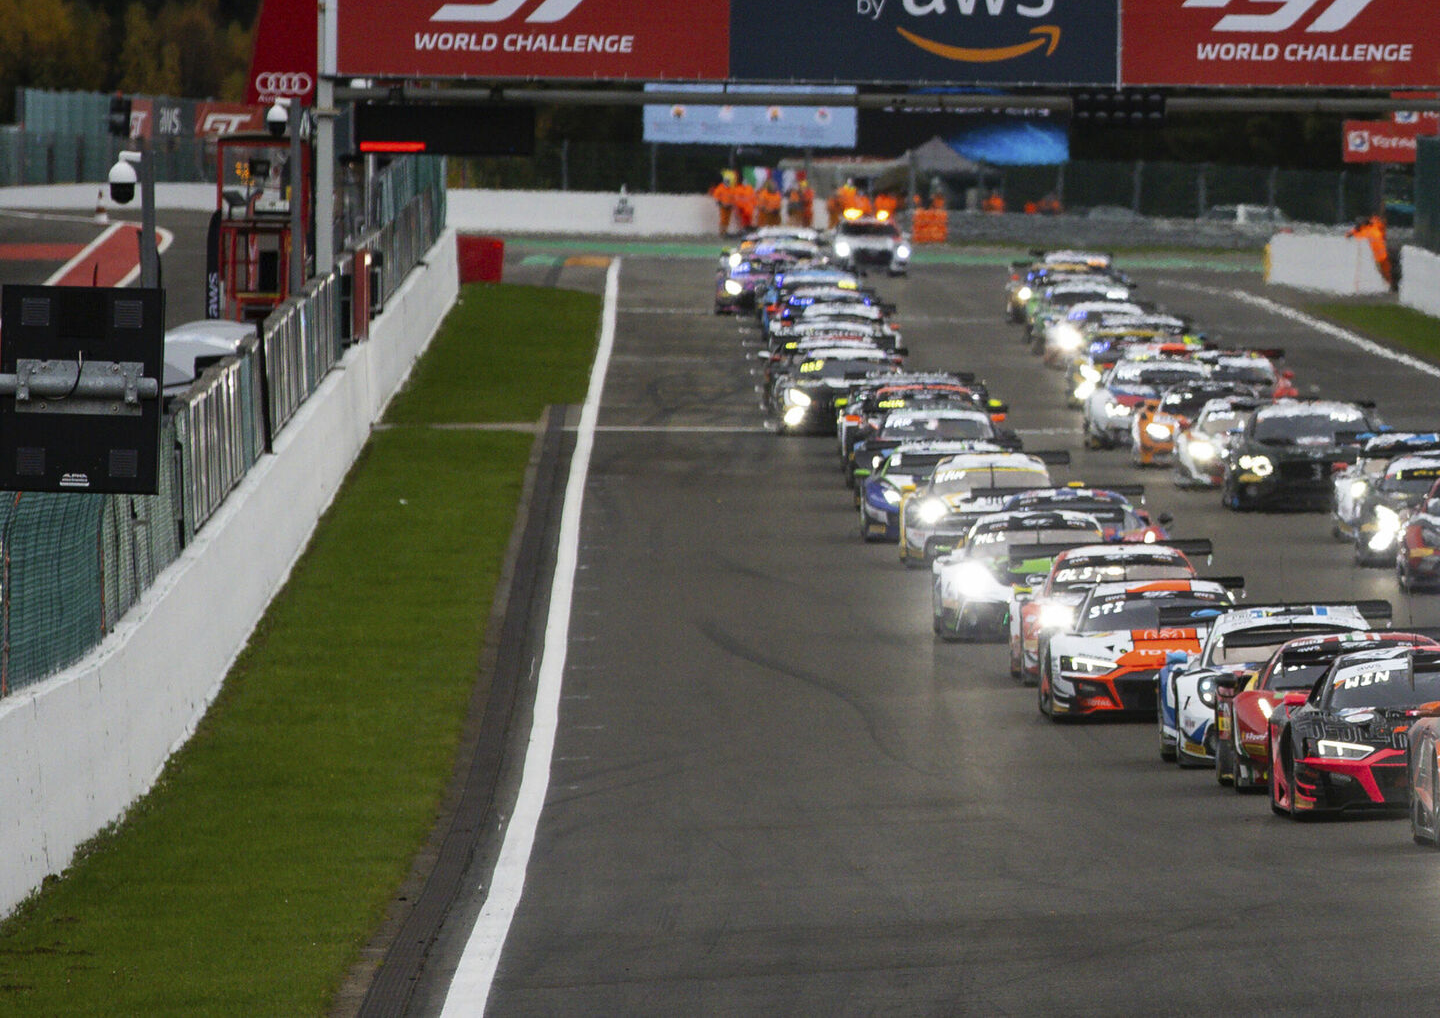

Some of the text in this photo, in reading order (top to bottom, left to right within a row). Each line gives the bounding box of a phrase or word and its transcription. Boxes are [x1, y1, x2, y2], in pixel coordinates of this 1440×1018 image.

[414, 33, 635, 54] WORLD CHALLENGE
[1197, 43, 1413, 62] WORLD CHALLENGE
[1088, 601, 1126, 619] STI
[1343, 670, 1391, 690] WIN
